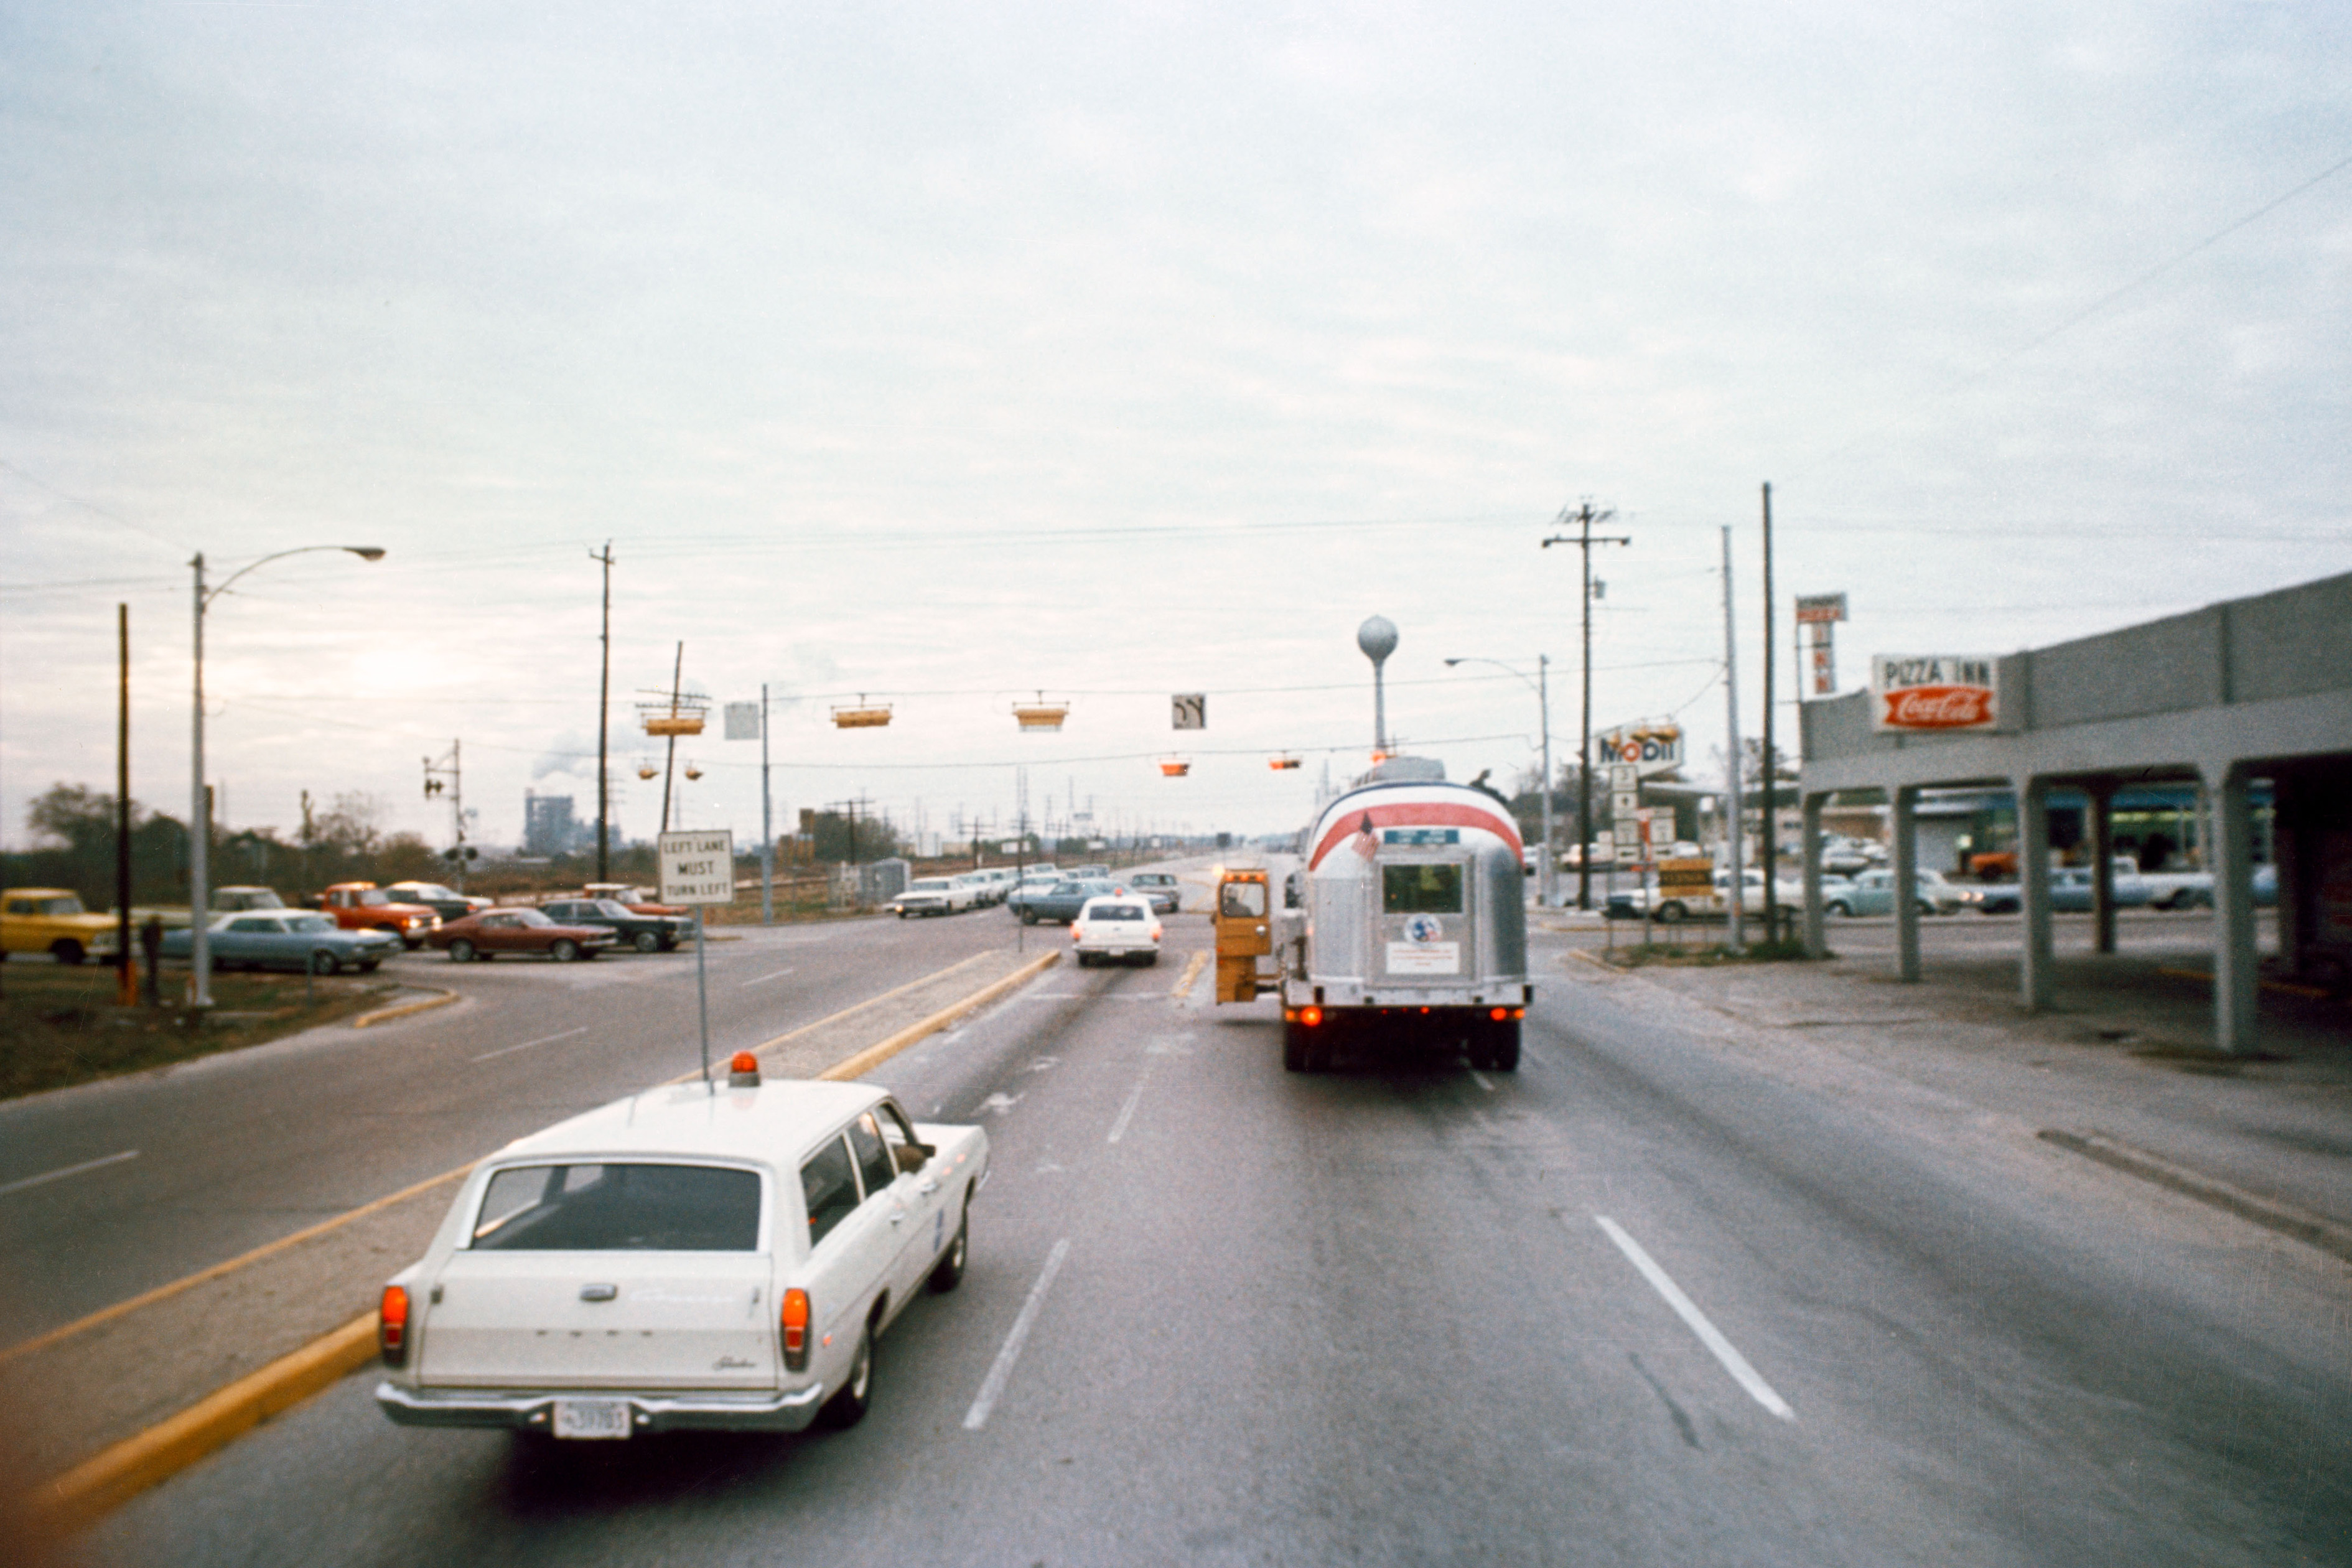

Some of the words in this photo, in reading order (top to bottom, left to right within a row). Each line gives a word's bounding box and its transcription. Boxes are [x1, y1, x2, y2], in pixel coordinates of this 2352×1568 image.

[1885, 660, 1943, 688] PIZZA
[1954, 660, 1990, 685] INN
[663, 841, 692, 854] LEFT
[697, 839, 726, 852] LANE
[678, 860, 713, 875] MUST
[666, 884, 696, 896] TURN
[699, 882, 727, 895] LEFT
